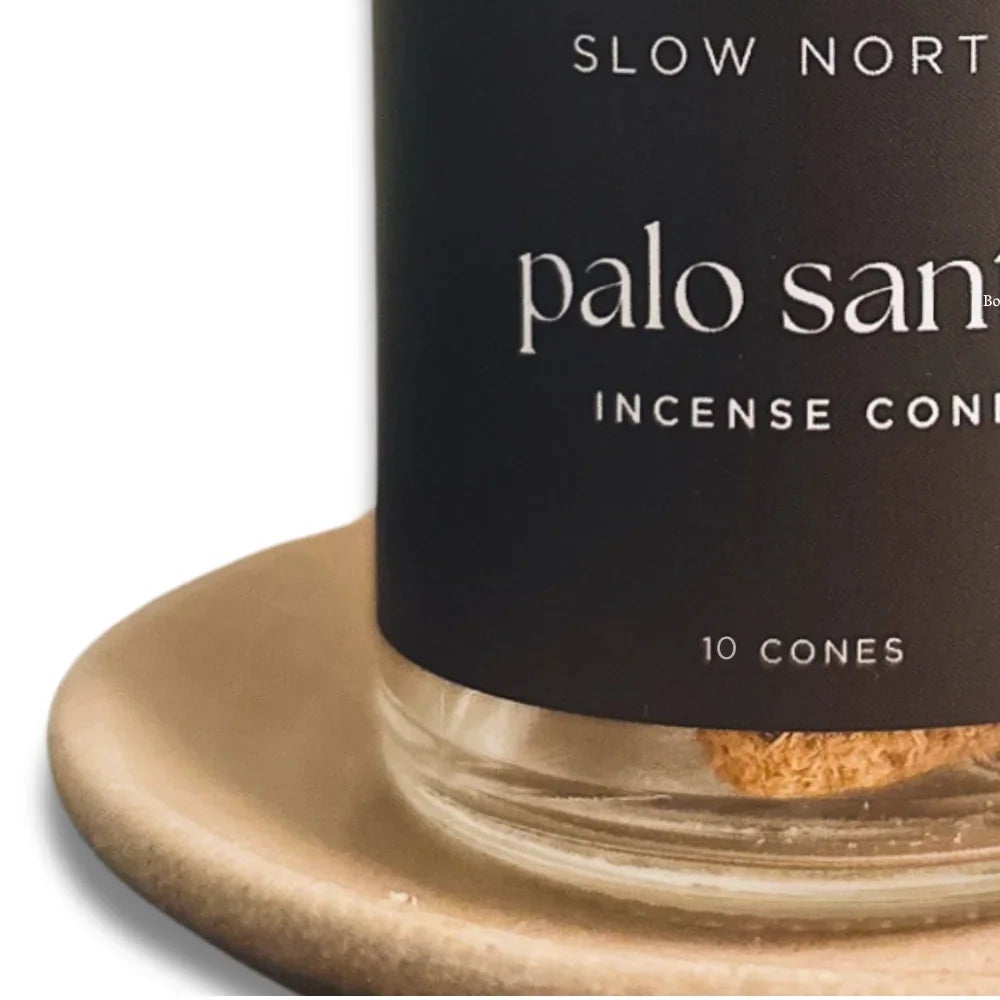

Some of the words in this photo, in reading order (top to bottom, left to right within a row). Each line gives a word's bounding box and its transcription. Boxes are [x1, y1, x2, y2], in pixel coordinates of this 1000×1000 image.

[573, 33, 756, 77] SLOW
[518, 220, 745, 356] palo
[595, 390, 832, 432] INCENSE
[702, 635, 737, 662] 10
[760, 637, 904, 666] CONES
